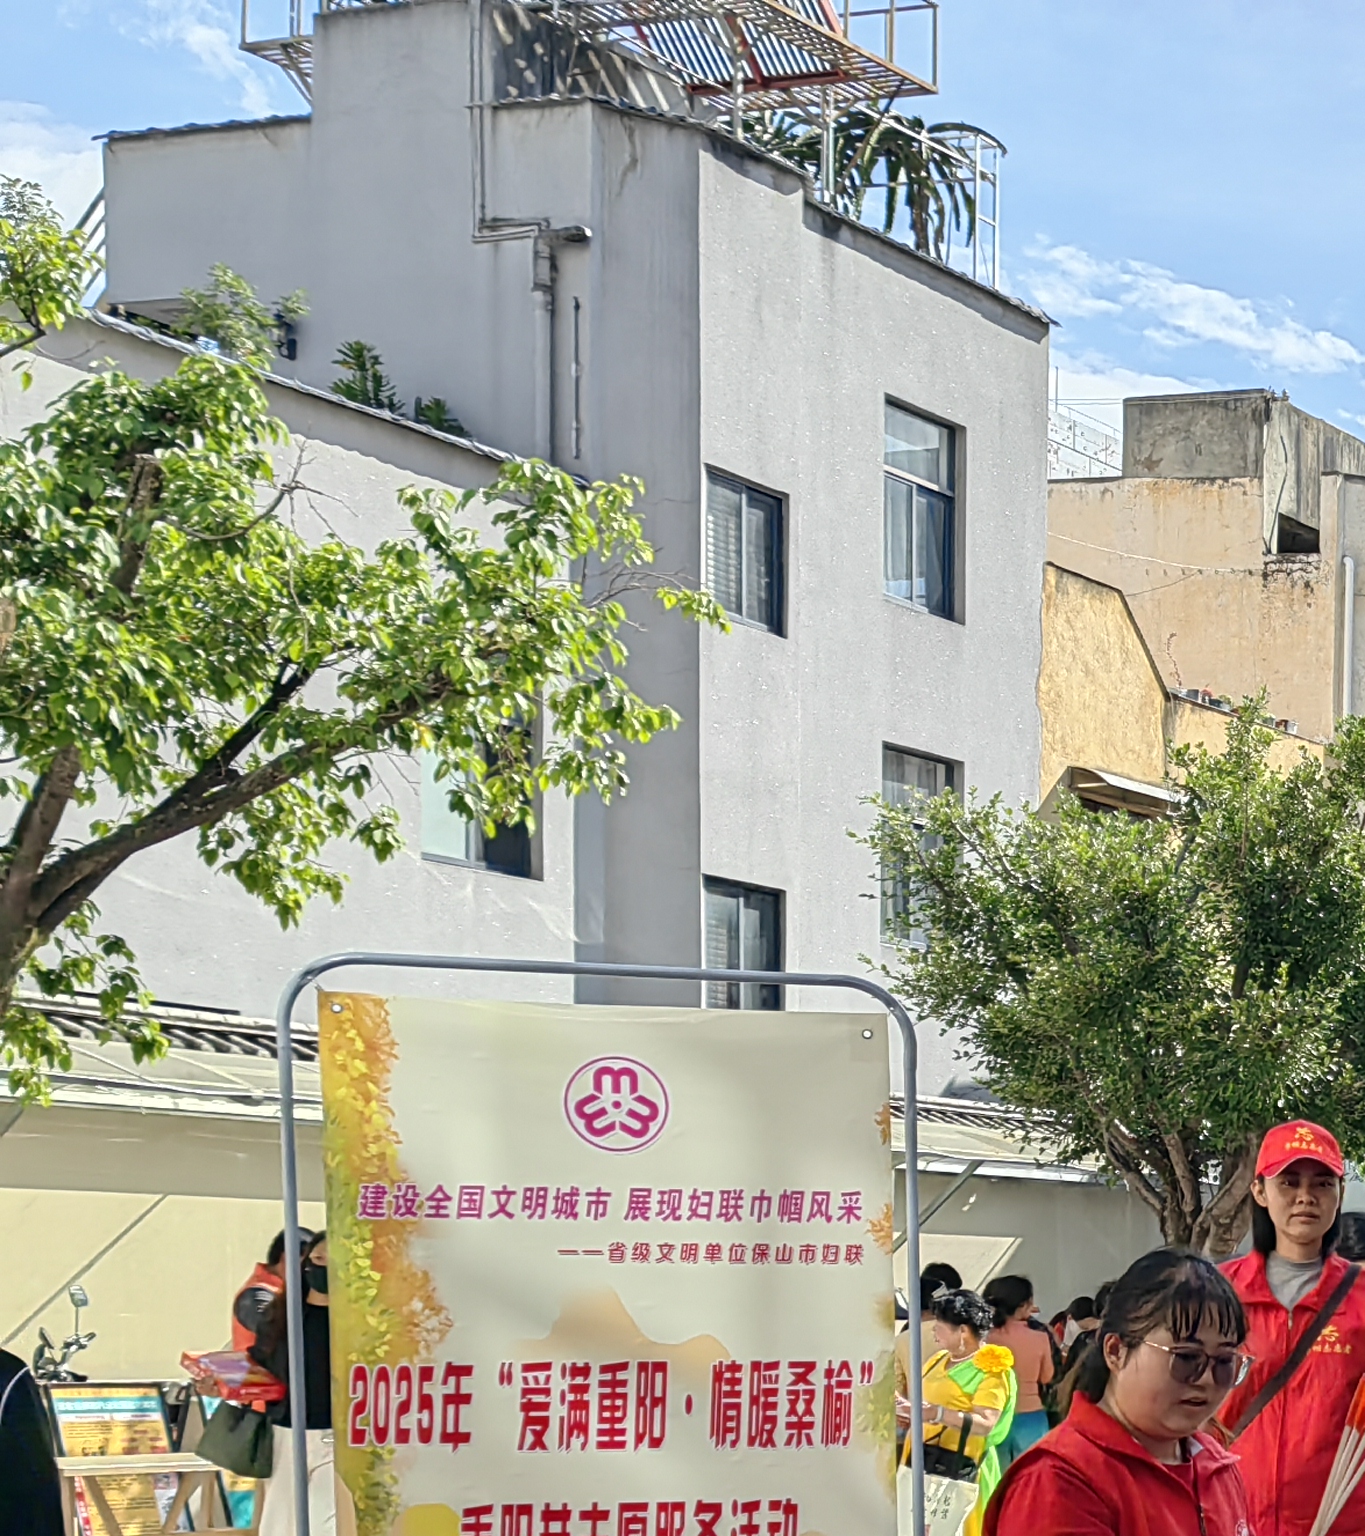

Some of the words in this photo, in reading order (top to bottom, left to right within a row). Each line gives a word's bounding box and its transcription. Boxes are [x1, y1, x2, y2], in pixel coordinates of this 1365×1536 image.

[357, 1184, 611, 1221] 建设全国文明城市
[623, 1187, 864, 1225] 展现妇联巾帼风采
